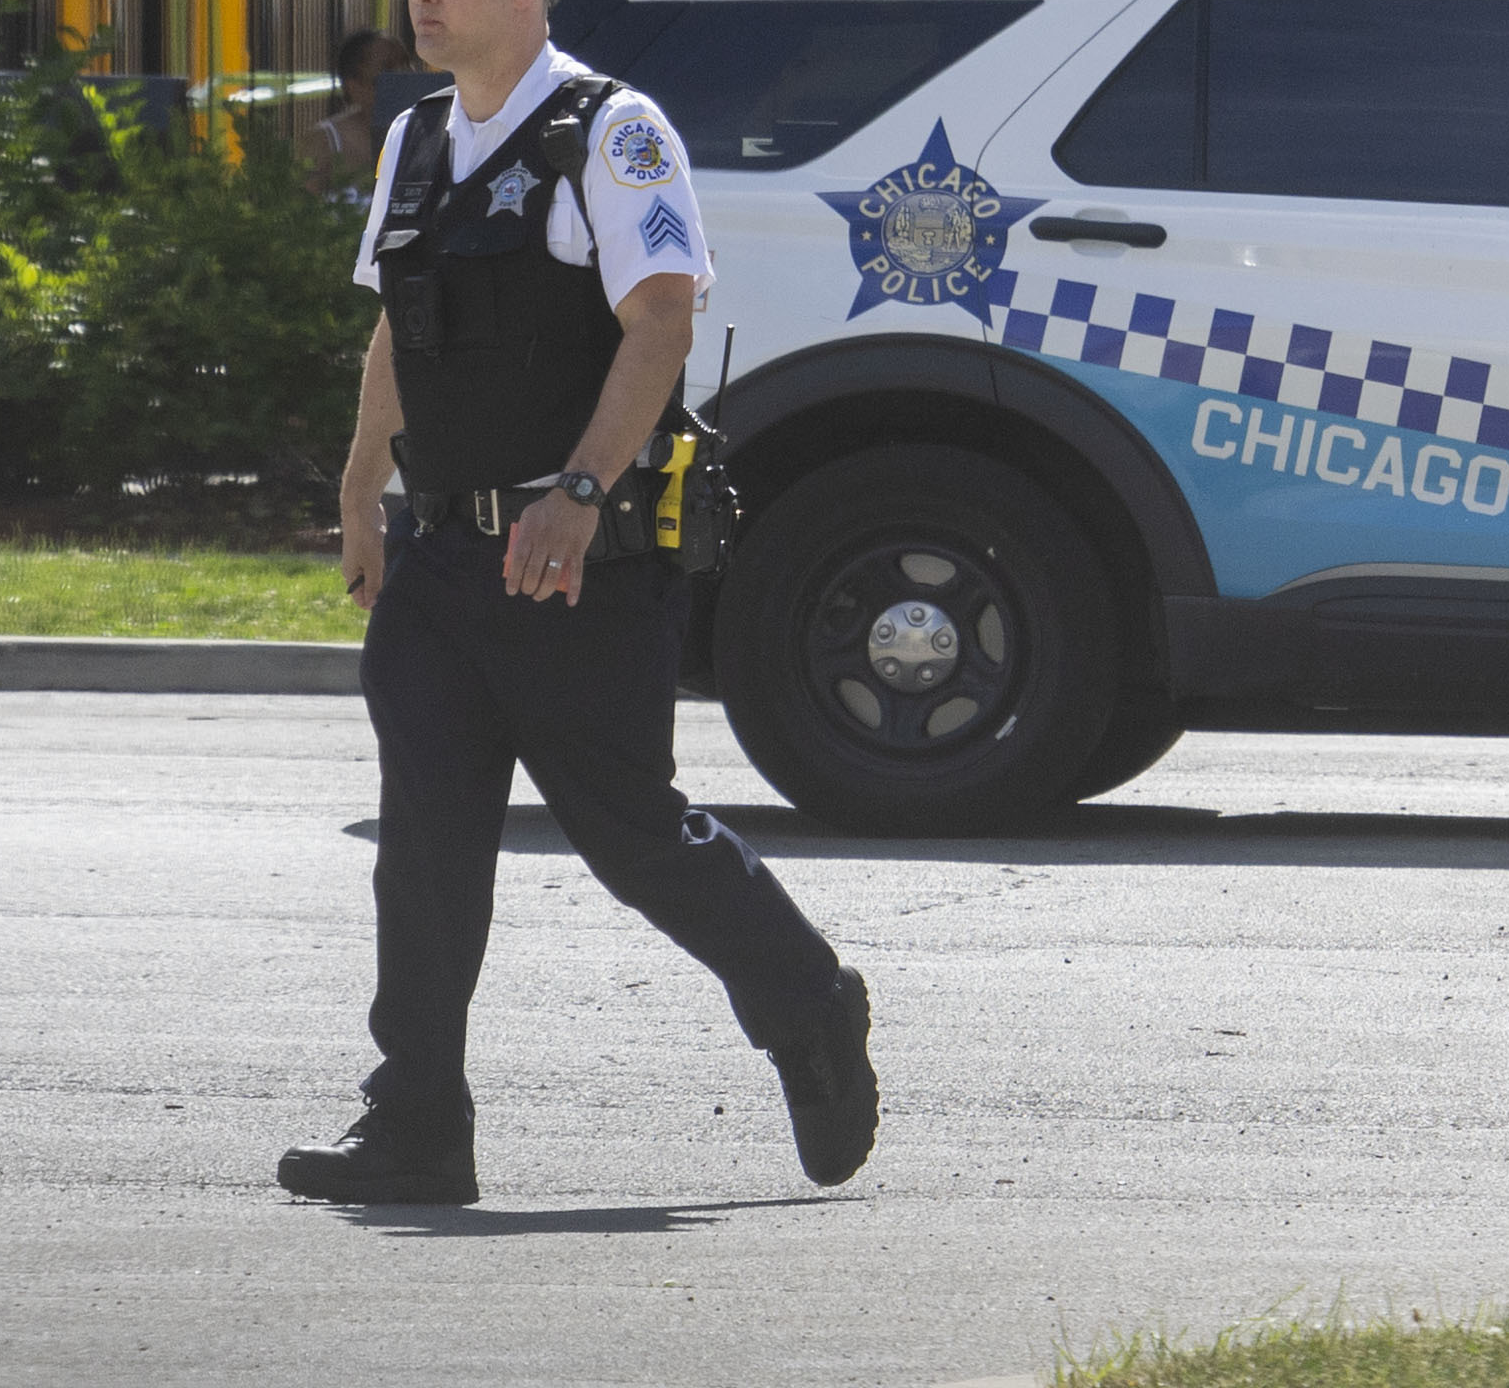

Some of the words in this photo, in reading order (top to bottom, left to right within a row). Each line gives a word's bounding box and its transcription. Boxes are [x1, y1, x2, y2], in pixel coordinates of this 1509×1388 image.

[612, 123, 664, 157] CHICAGO
[625, 158, 670, 180] POLICE
[859, 163, 1001, 219] CHICAGO
[861, 255, 992, 303] POLICE
